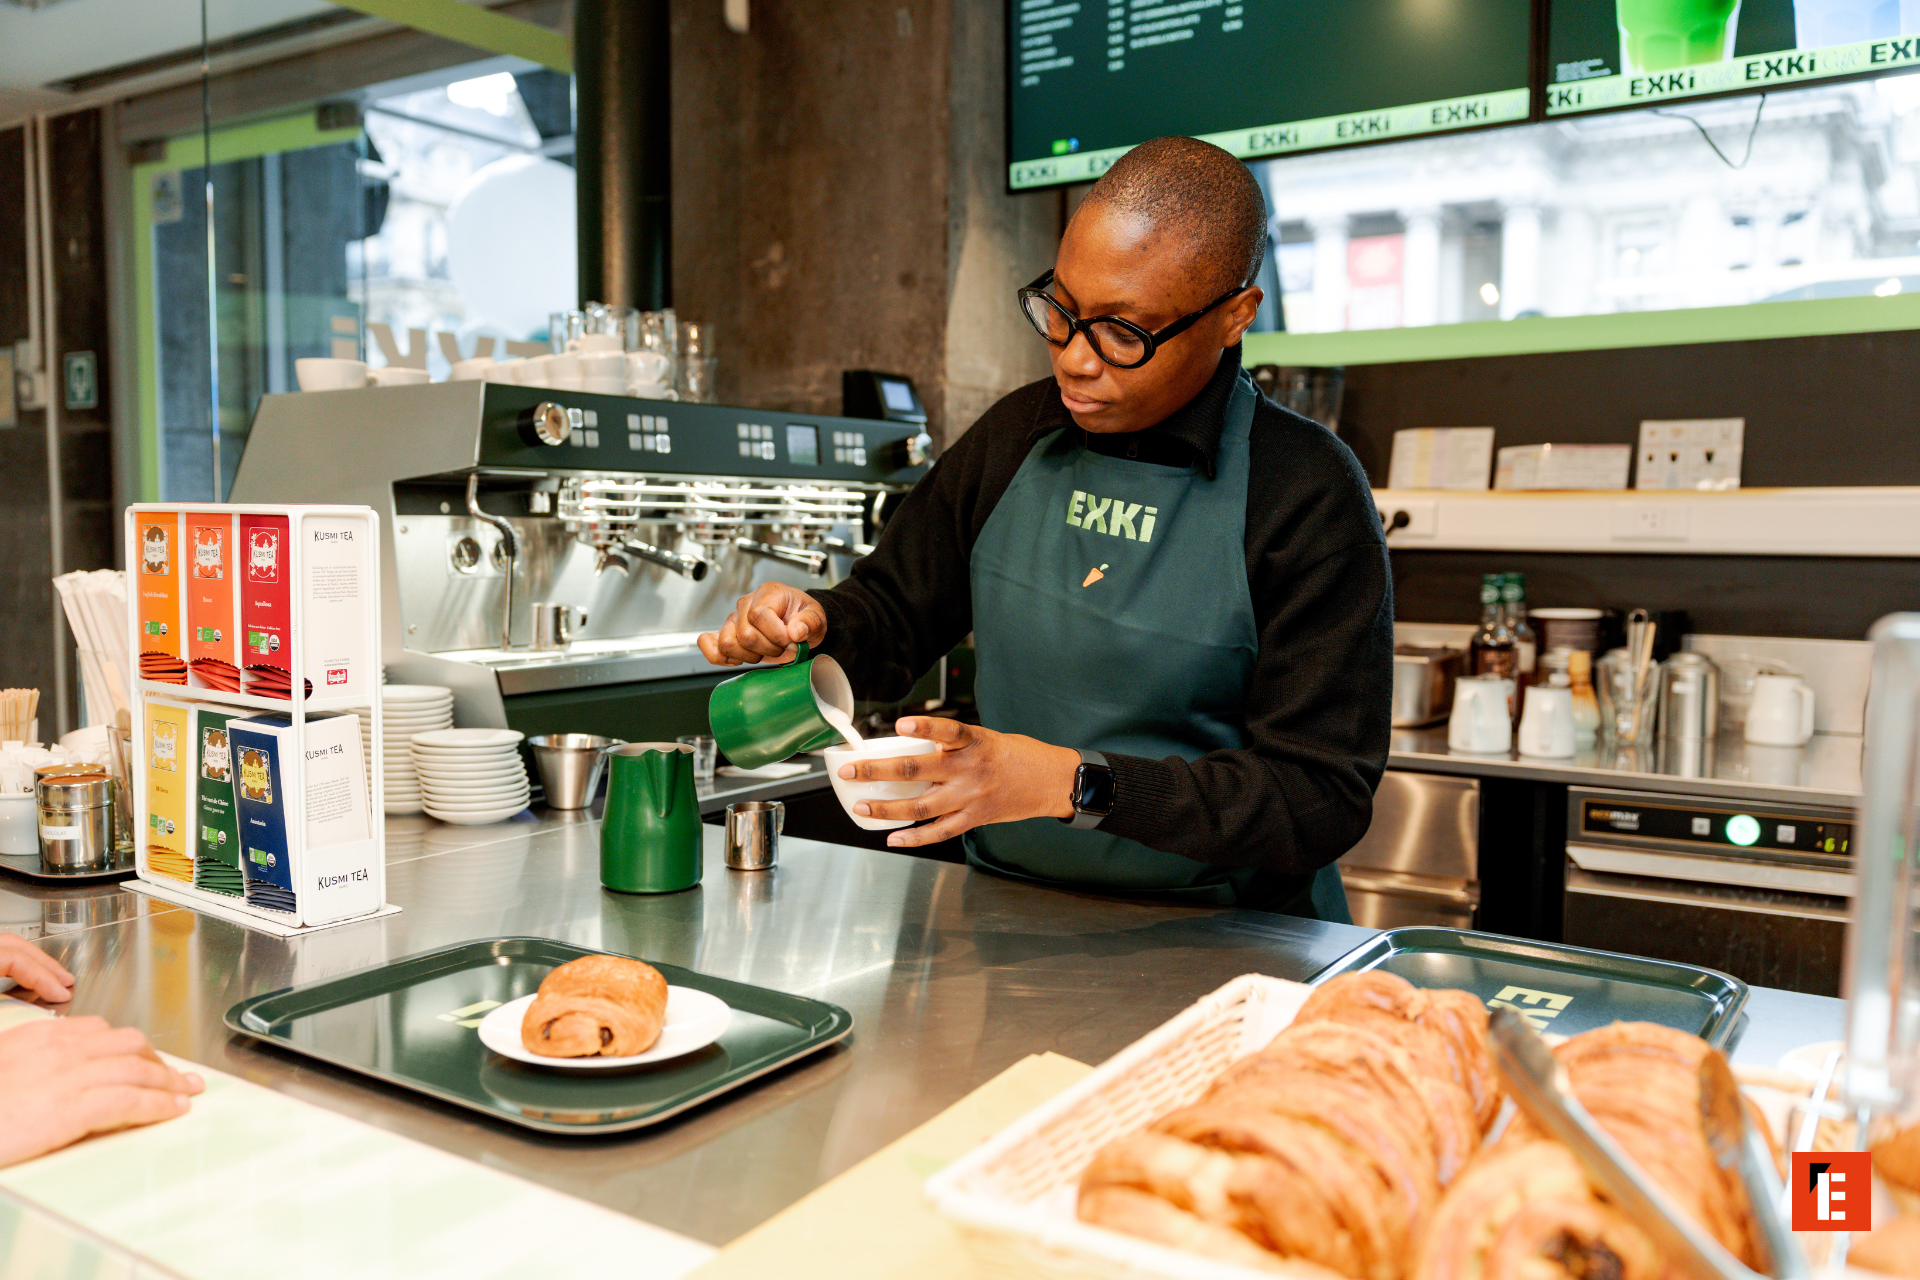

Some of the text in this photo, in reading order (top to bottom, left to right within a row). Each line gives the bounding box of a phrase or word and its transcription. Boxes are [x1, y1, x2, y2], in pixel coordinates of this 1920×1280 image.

[1629, 72, 1696, 97] EXKi
[1745, 52, 1816, 81] EXKi
[1248, 127, 1298, 151] EXKi
[1336, 113, 1390, 138] EXKi
[1431, 99, 1488, 125] EXKi
[1066, 490, 1158, 543] EXKi
[314, 530, 354, 542] KUSMI TEA
[145, 546, 165, 554] KUSMI TEA
[198, 549, 218, 558] KUSMI TEA
[252, 549, 274, 559] KUSMI TEA
[154, 740, 166, 749] KUSMI
[329, 744, 344, 754] TEA
[206, 748, 226, 760] KUSMI TEA
[243, 769, 265, 781] KUSMI TEA
[318, 868, 369, 891] KUSMI TEA
